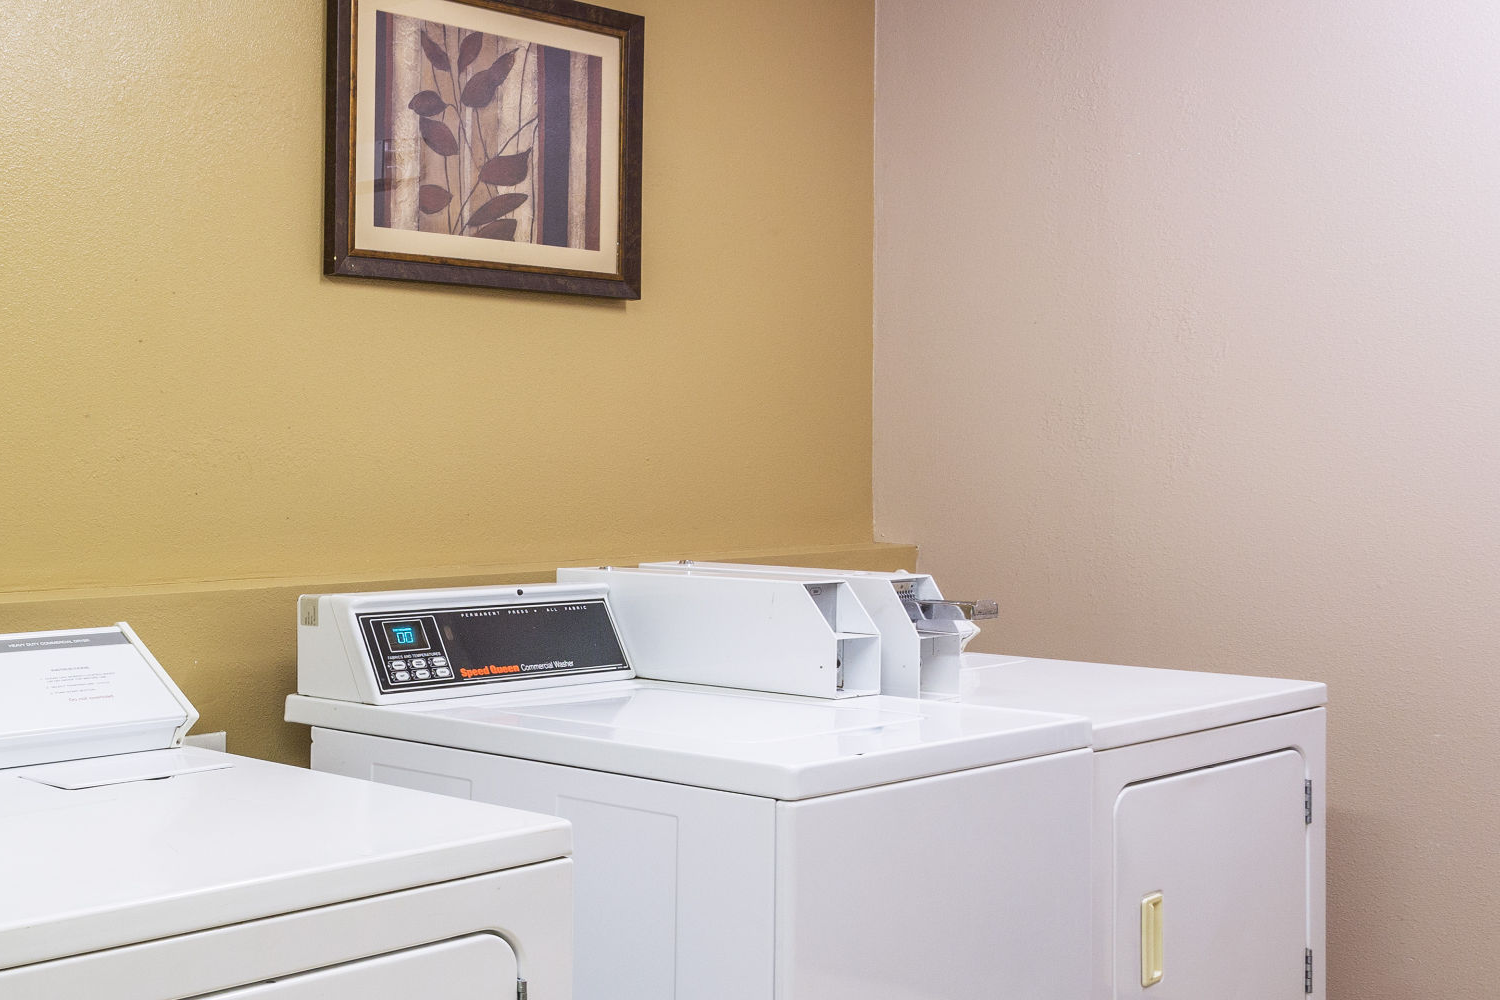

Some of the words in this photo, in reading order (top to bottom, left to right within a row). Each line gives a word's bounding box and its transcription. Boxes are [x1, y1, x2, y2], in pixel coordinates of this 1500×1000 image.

[459, 664, 490, 679] Speed
[490, 664, 521, 675] Queen
[520, 660, 553, 672] Commercial
[553, 659, 574, 668] Washer
